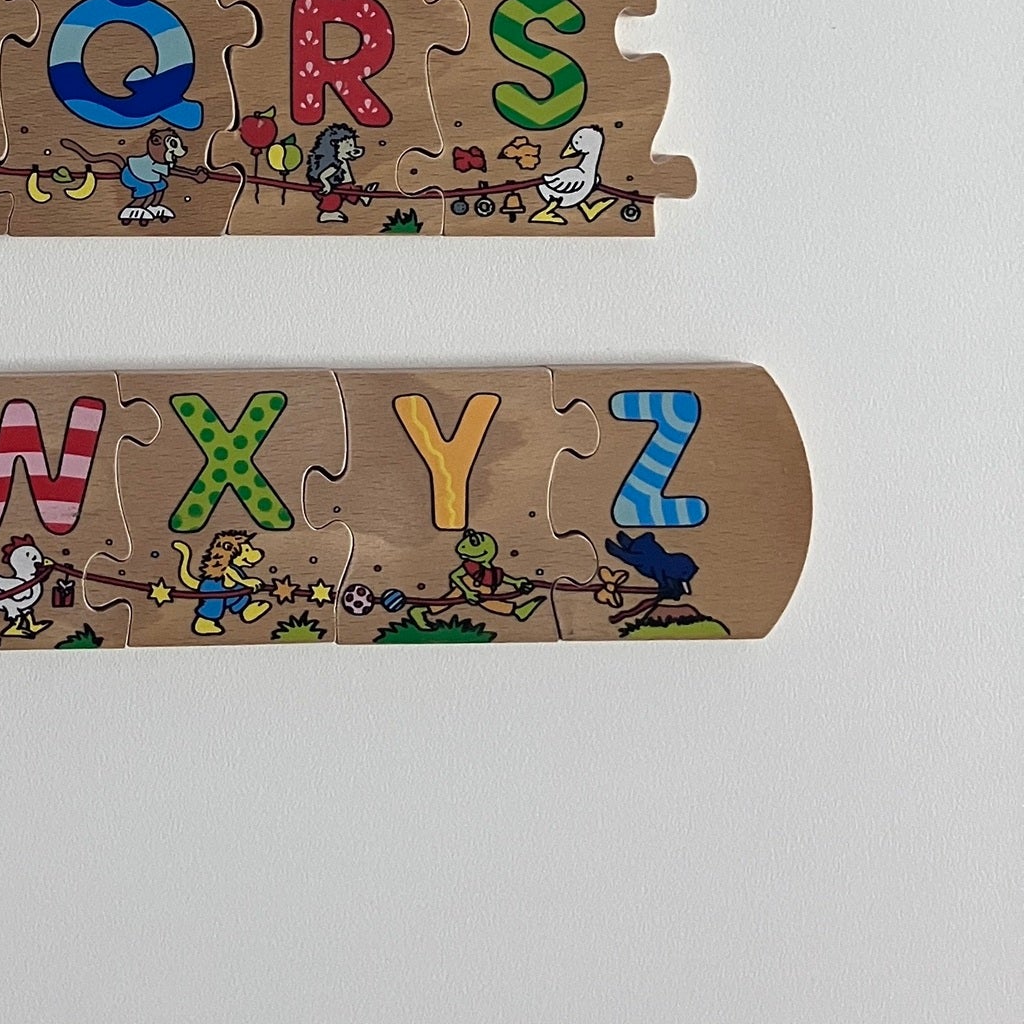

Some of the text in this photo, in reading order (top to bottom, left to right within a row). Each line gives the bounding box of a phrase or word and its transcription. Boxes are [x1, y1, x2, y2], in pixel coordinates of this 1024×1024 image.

[168, 390, 294, 533] X
[392, 392, 501, 532] Y
[610, 389, 709, 529] Z
